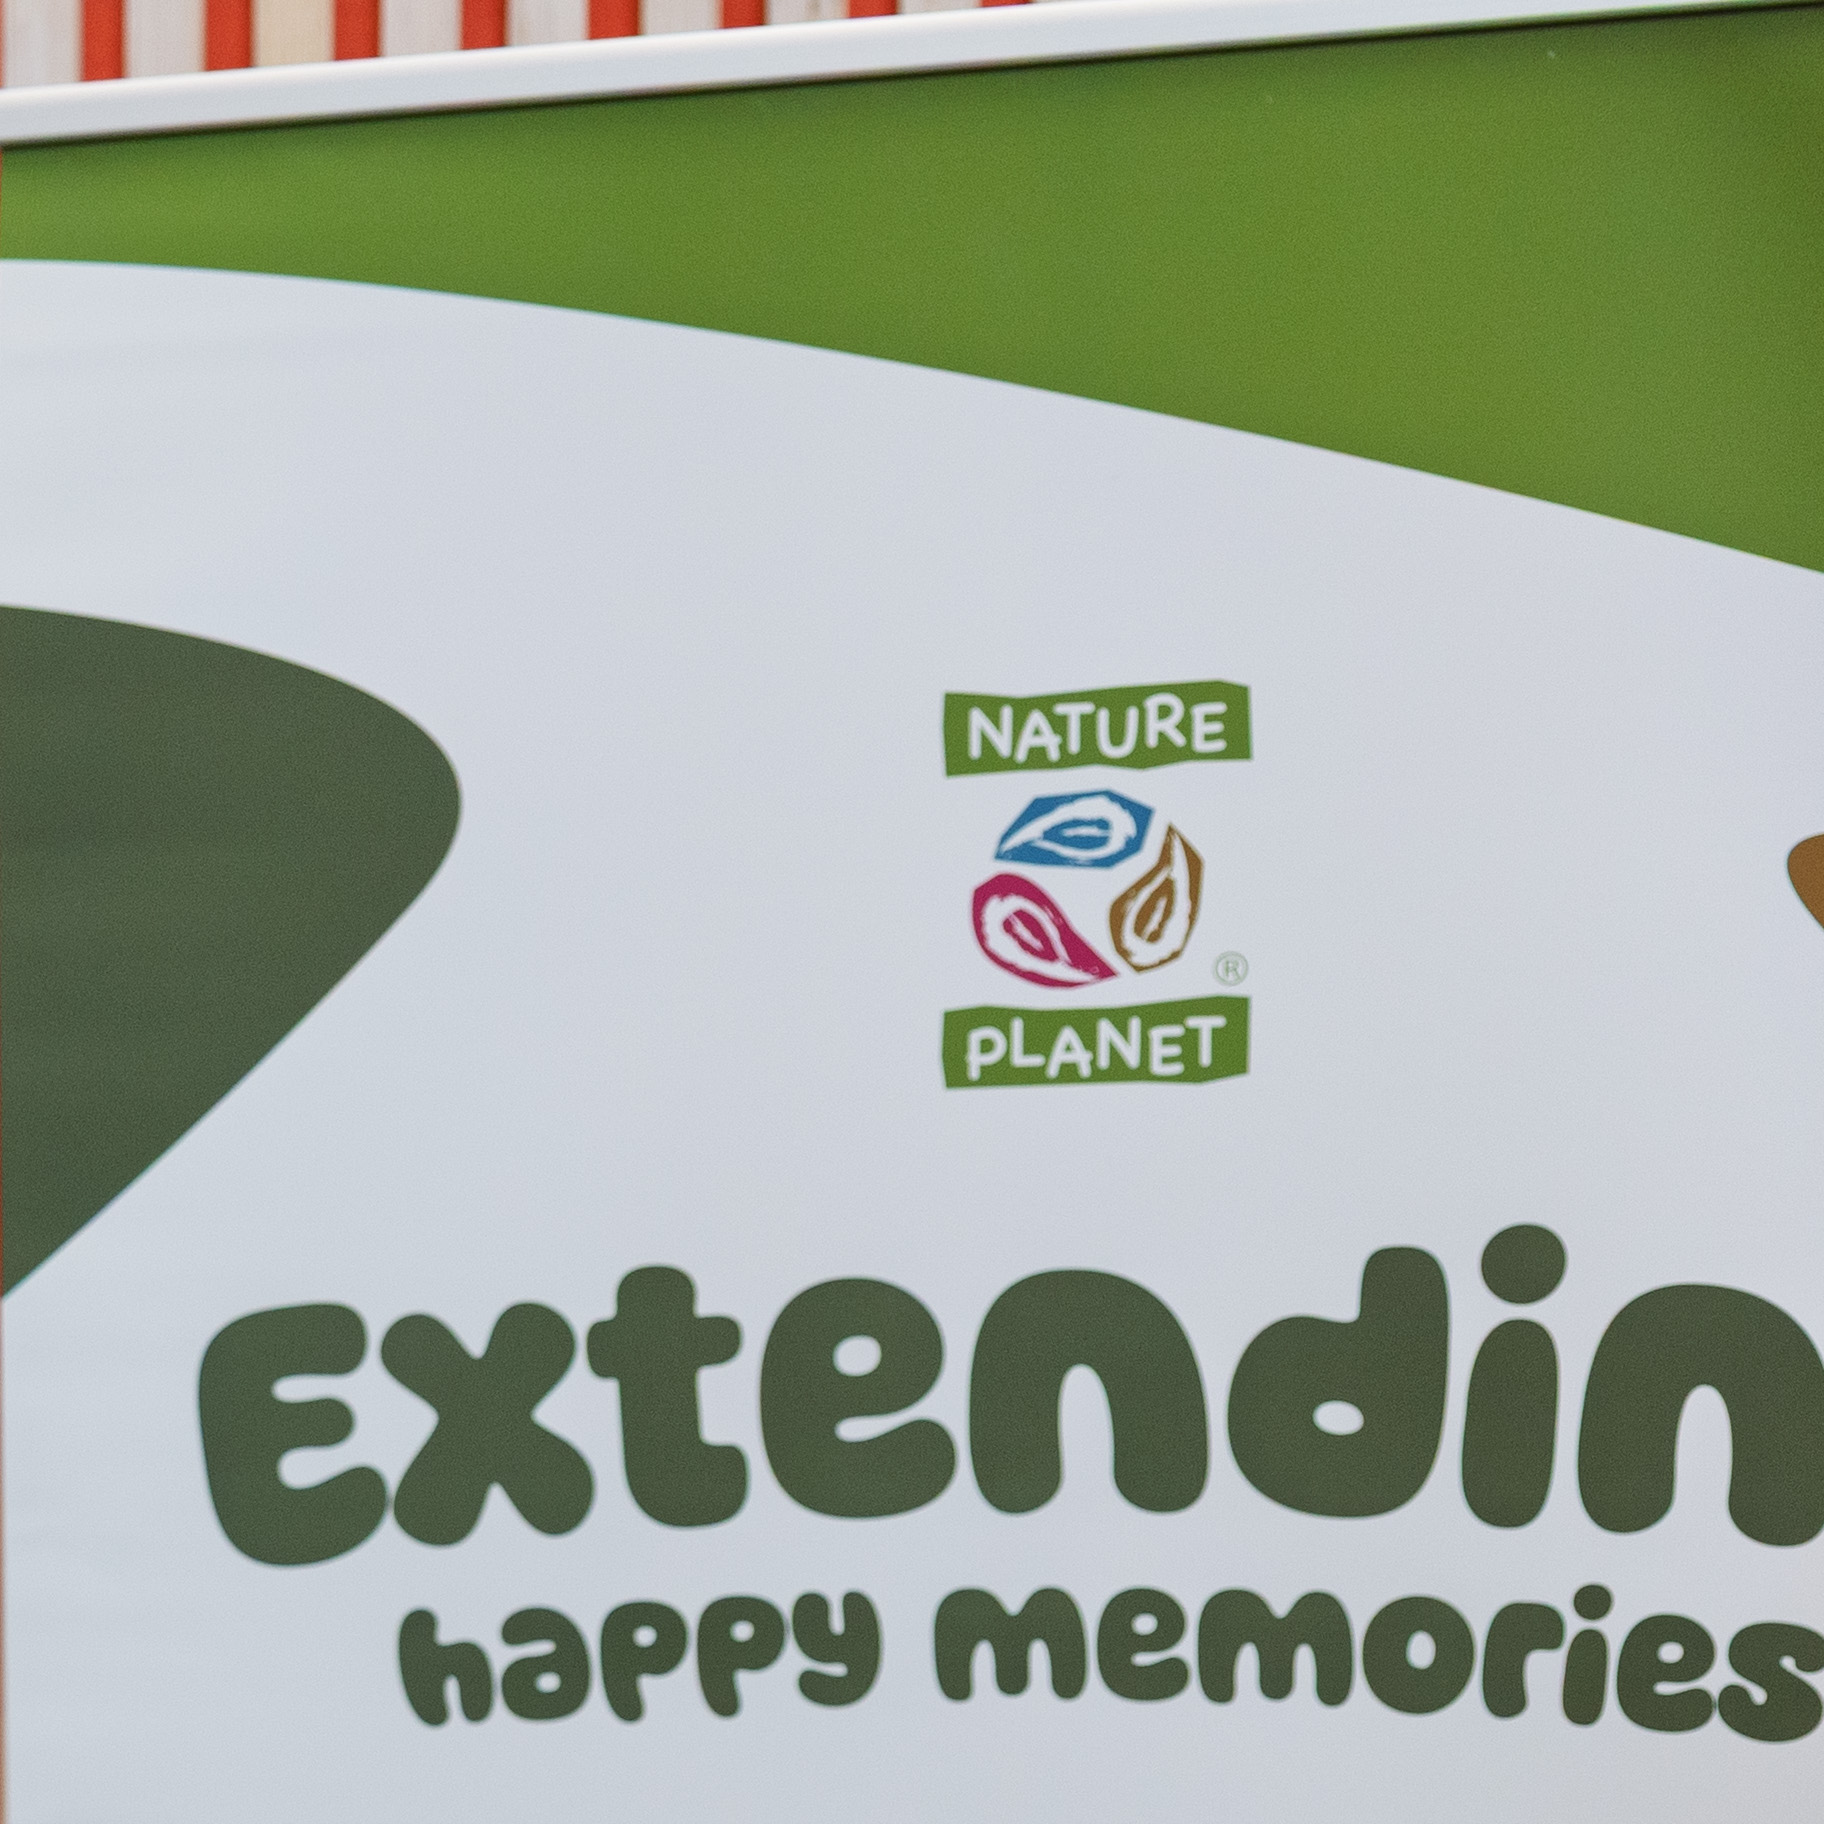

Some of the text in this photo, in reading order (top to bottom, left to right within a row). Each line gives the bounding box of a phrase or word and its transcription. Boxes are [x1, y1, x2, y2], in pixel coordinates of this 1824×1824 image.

[966, 692, 1228, 763] NATURE
[964, 1014, 1228, 1081] PLANET
[198, 1223, 1824, 1568] Extendin
[397, 1583, 1824, 1744] happy memories
